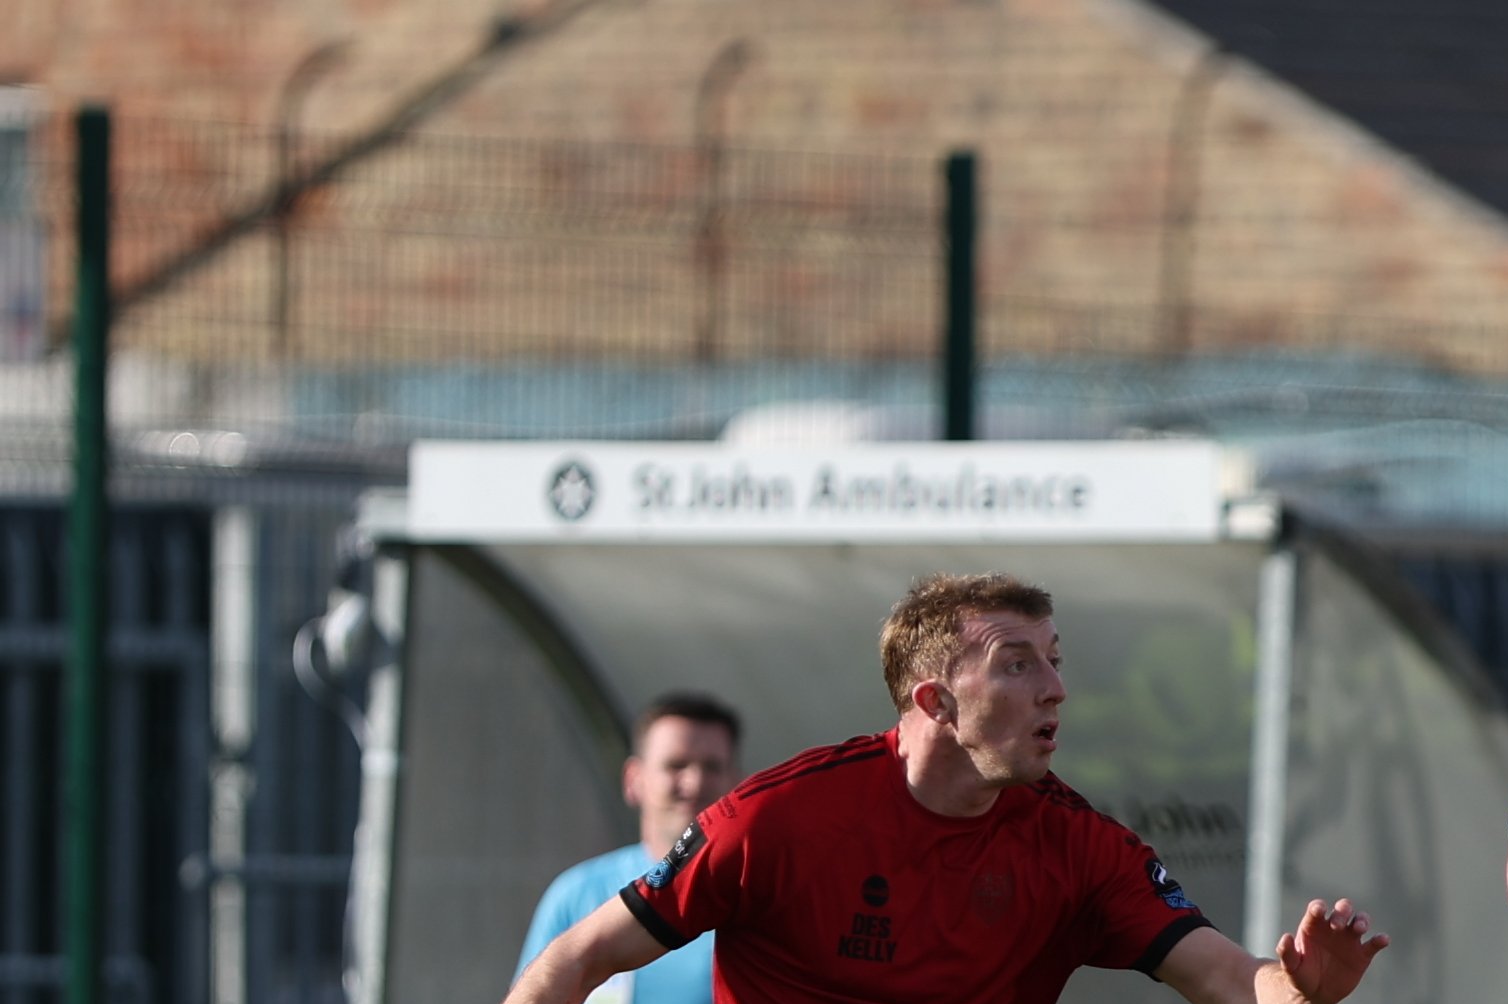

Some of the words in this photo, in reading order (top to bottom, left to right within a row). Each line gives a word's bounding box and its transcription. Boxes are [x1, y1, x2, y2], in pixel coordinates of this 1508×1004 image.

[690, 463, 794, 512] John
[810, 463, 1092, 512] Ambulance
[851, 912, 892, 939] DES
[837, 935, 898, 964] KELLY
